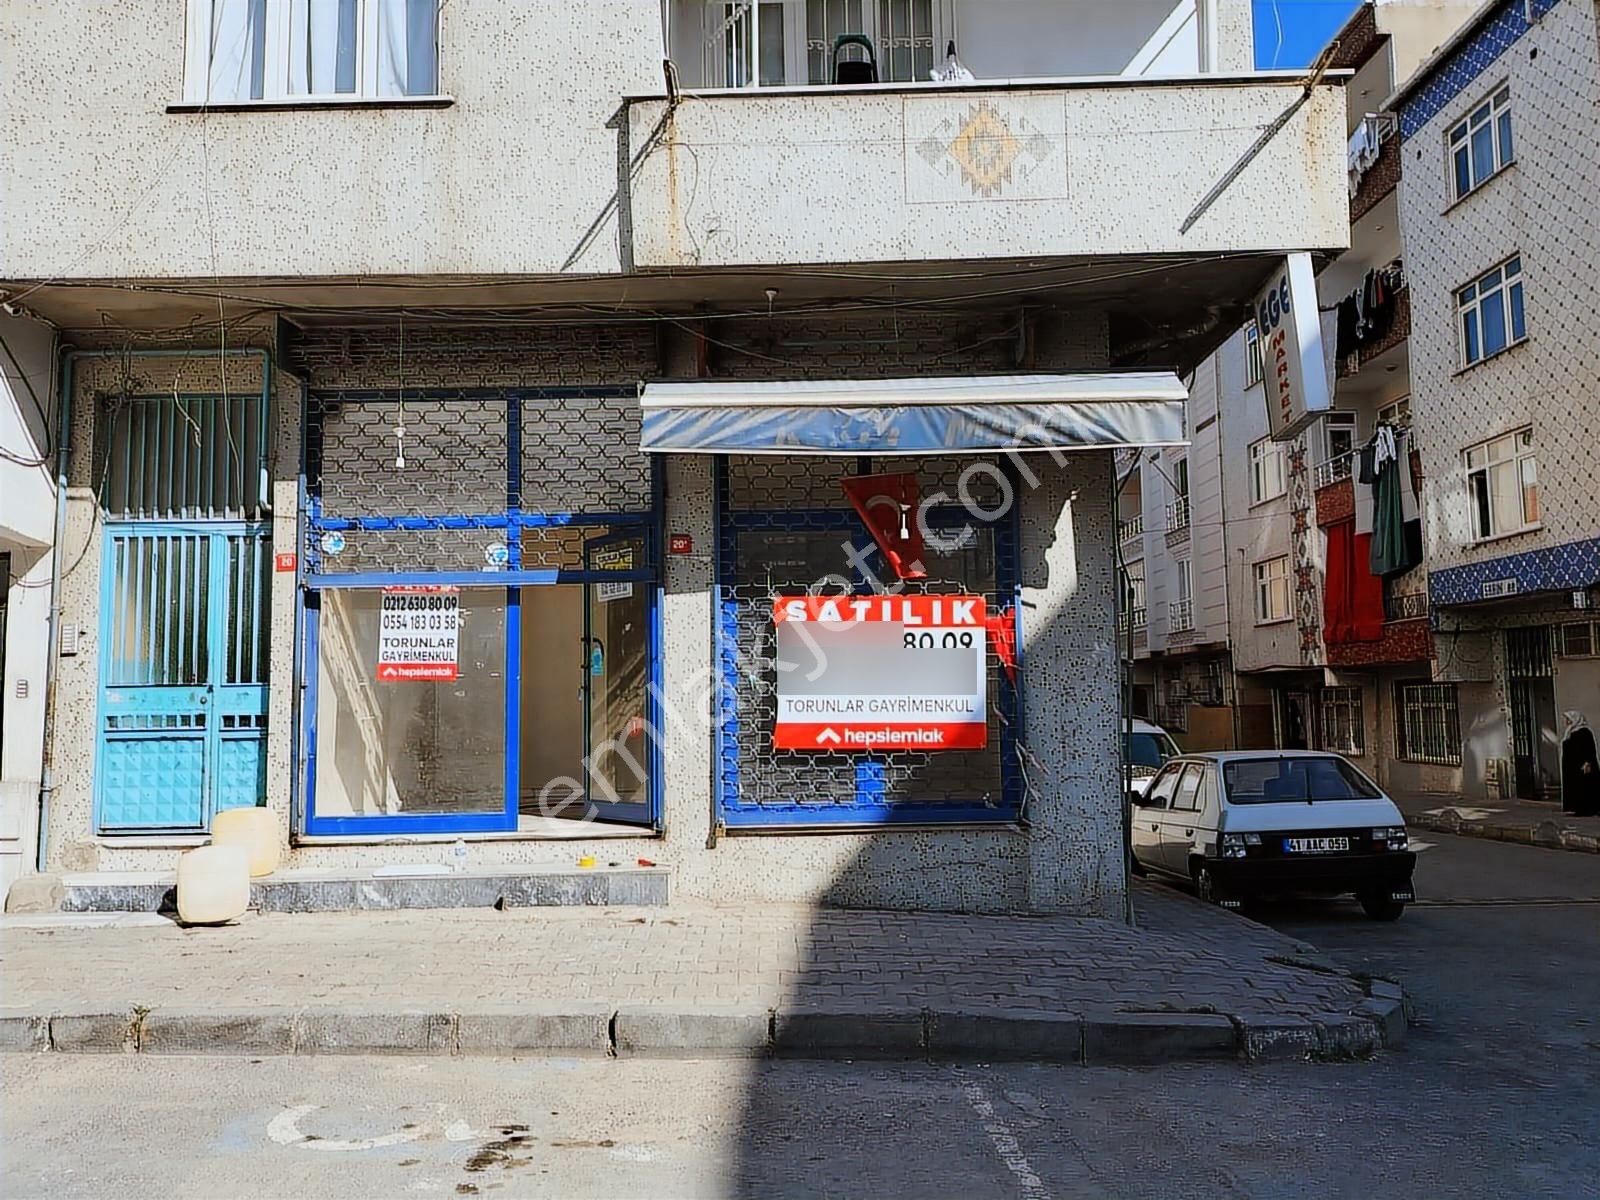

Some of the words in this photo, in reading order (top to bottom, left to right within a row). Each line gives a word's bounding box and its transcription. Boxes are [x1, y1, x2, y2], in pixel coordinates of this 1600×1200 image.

[1259, 275, 1290, 336] EGE
[1273, 329, 1292, 423] MARKET
[383, 596, 407, 611] 0212
[407, 596, 426, 611] 630
[428, 596, 442, 611] 80
[443, 596, 457, 611] 09
[785, 600, 977, 625] SATILIK
[383, 615, 407, 630] 0554
[410, 615, 426, 630] 183
[383, 638, 455, 648] TORUNLAR
[904, 632, 934, 648] 80
[382, 649, 455, 661] GAYRİMENKUL
[786, 699, 864, 713] TORUNLAR
[868, 696, 974, 713] GAYRİMENKUL
[844, 728, 944, 746] hepsiemlak
